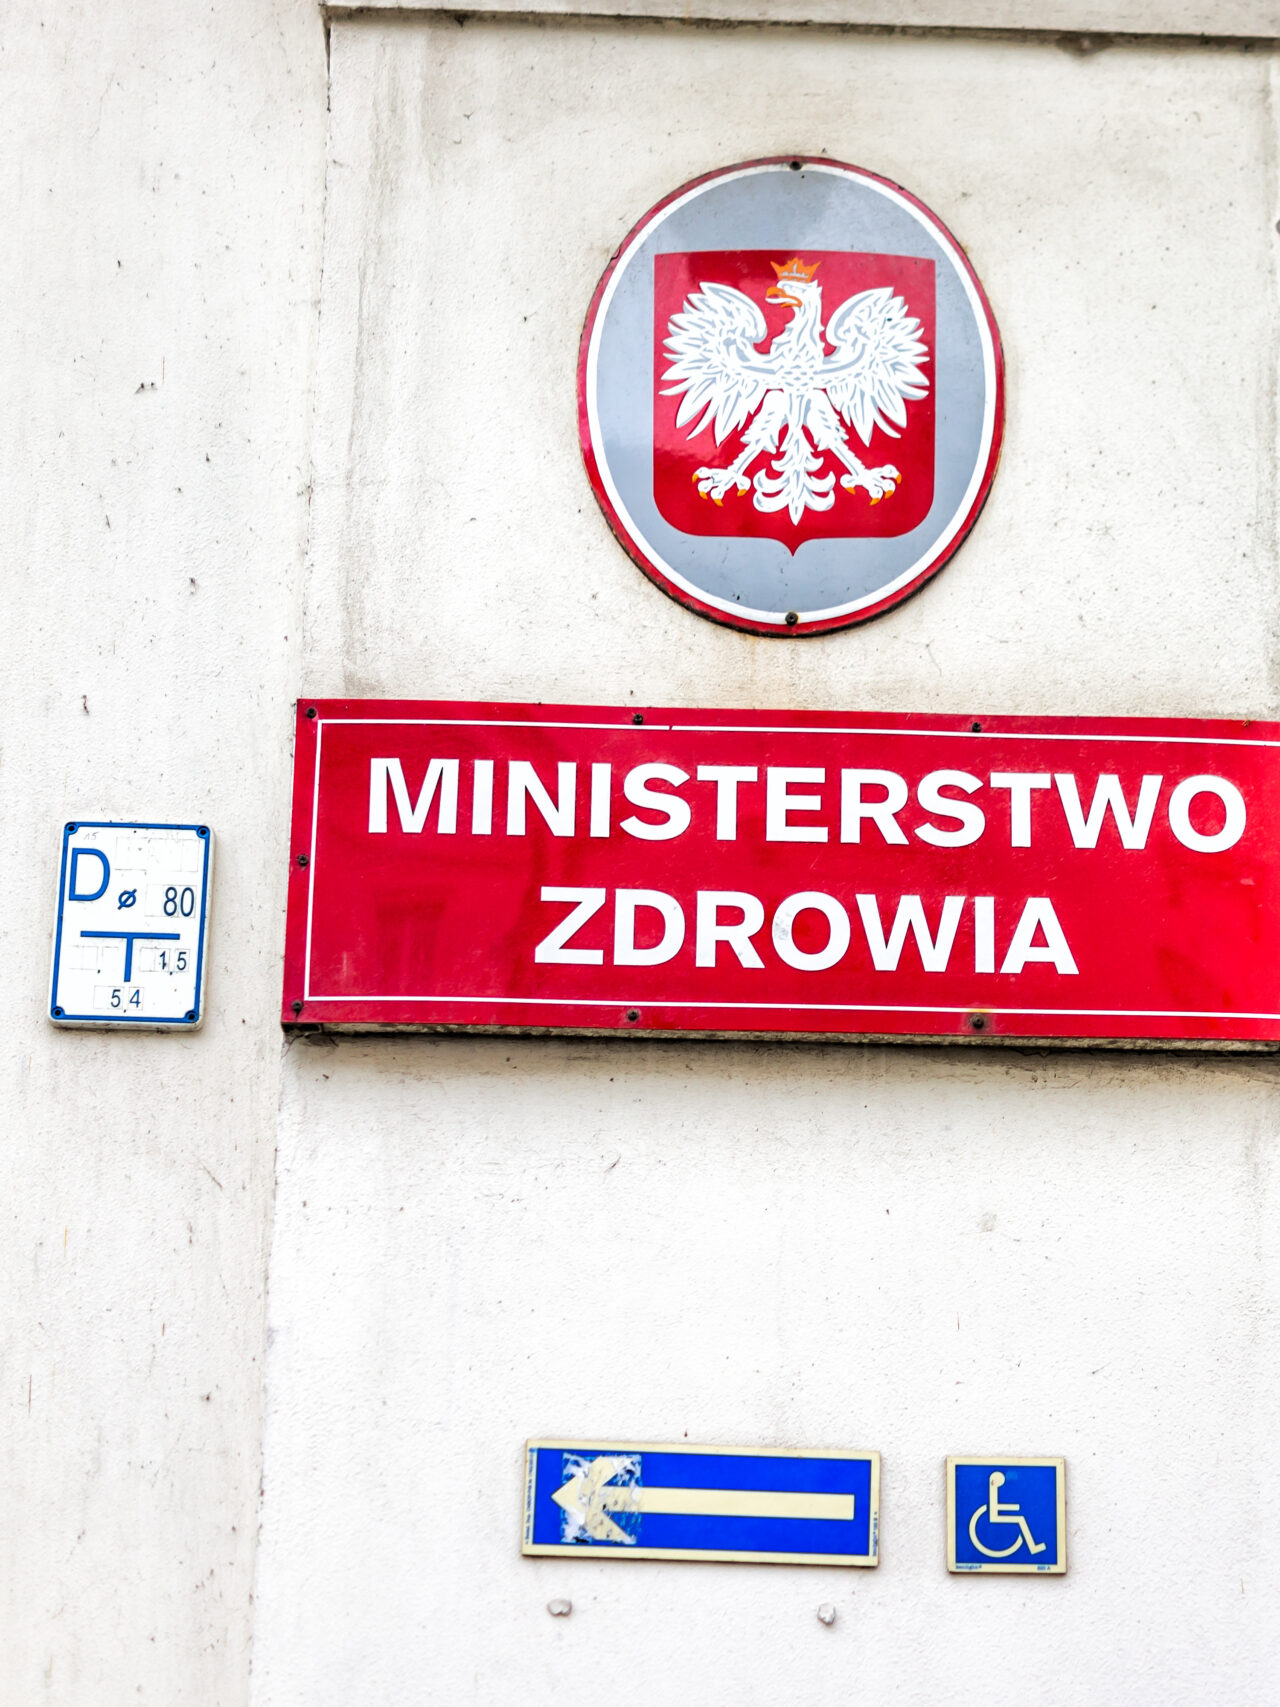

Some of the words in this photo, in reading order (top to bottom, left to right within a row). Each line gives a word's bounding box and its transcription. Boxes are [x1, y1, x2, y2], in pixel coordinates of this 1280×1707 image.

[368, 758, 1247, 853] MINISTERSTWO
[68, 847, 111, 901] D
[163, 886, 195, 918] 80
[534, 886, 1080, 975] ZDROWIA
